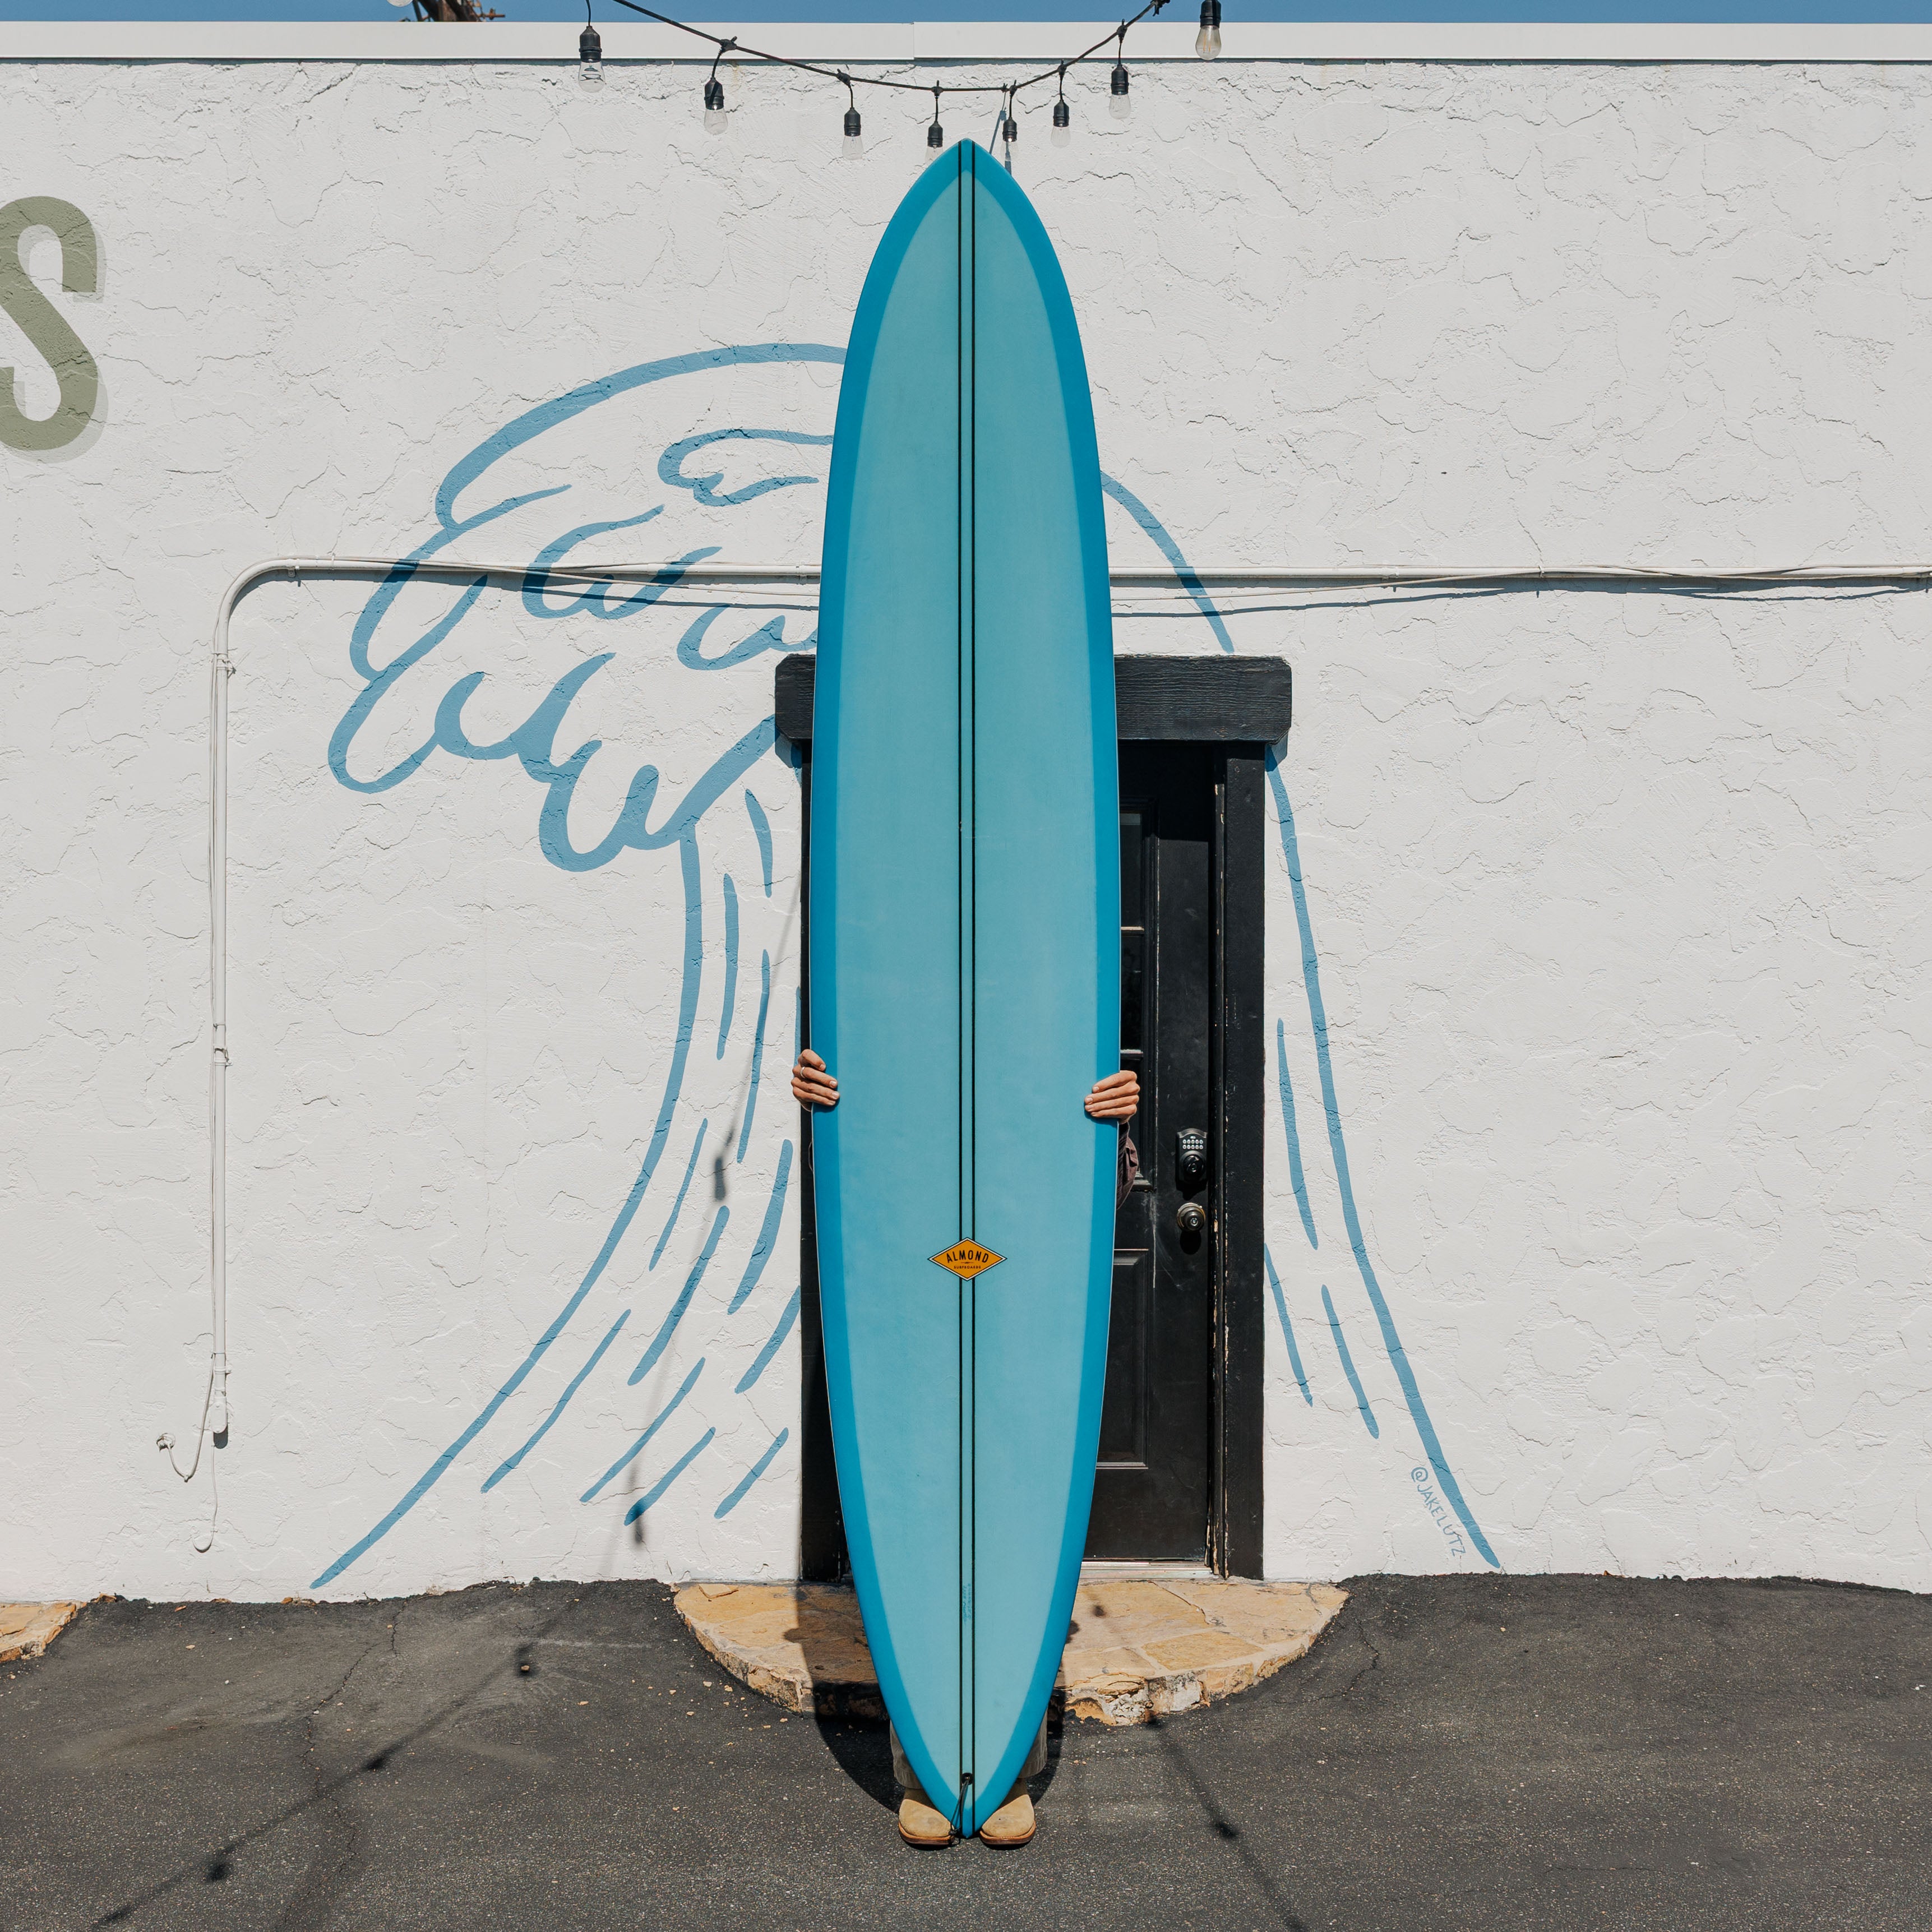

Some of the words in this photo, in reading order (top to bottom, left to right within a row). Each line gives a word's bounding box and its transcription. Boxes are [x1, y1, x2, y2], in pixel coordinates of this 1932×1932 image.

[0, 195, 98, 451] S
[946, 1250, 989, 1263] ALMOND
[1411, 1467, 1466, 1557] @JAKELUTZ
